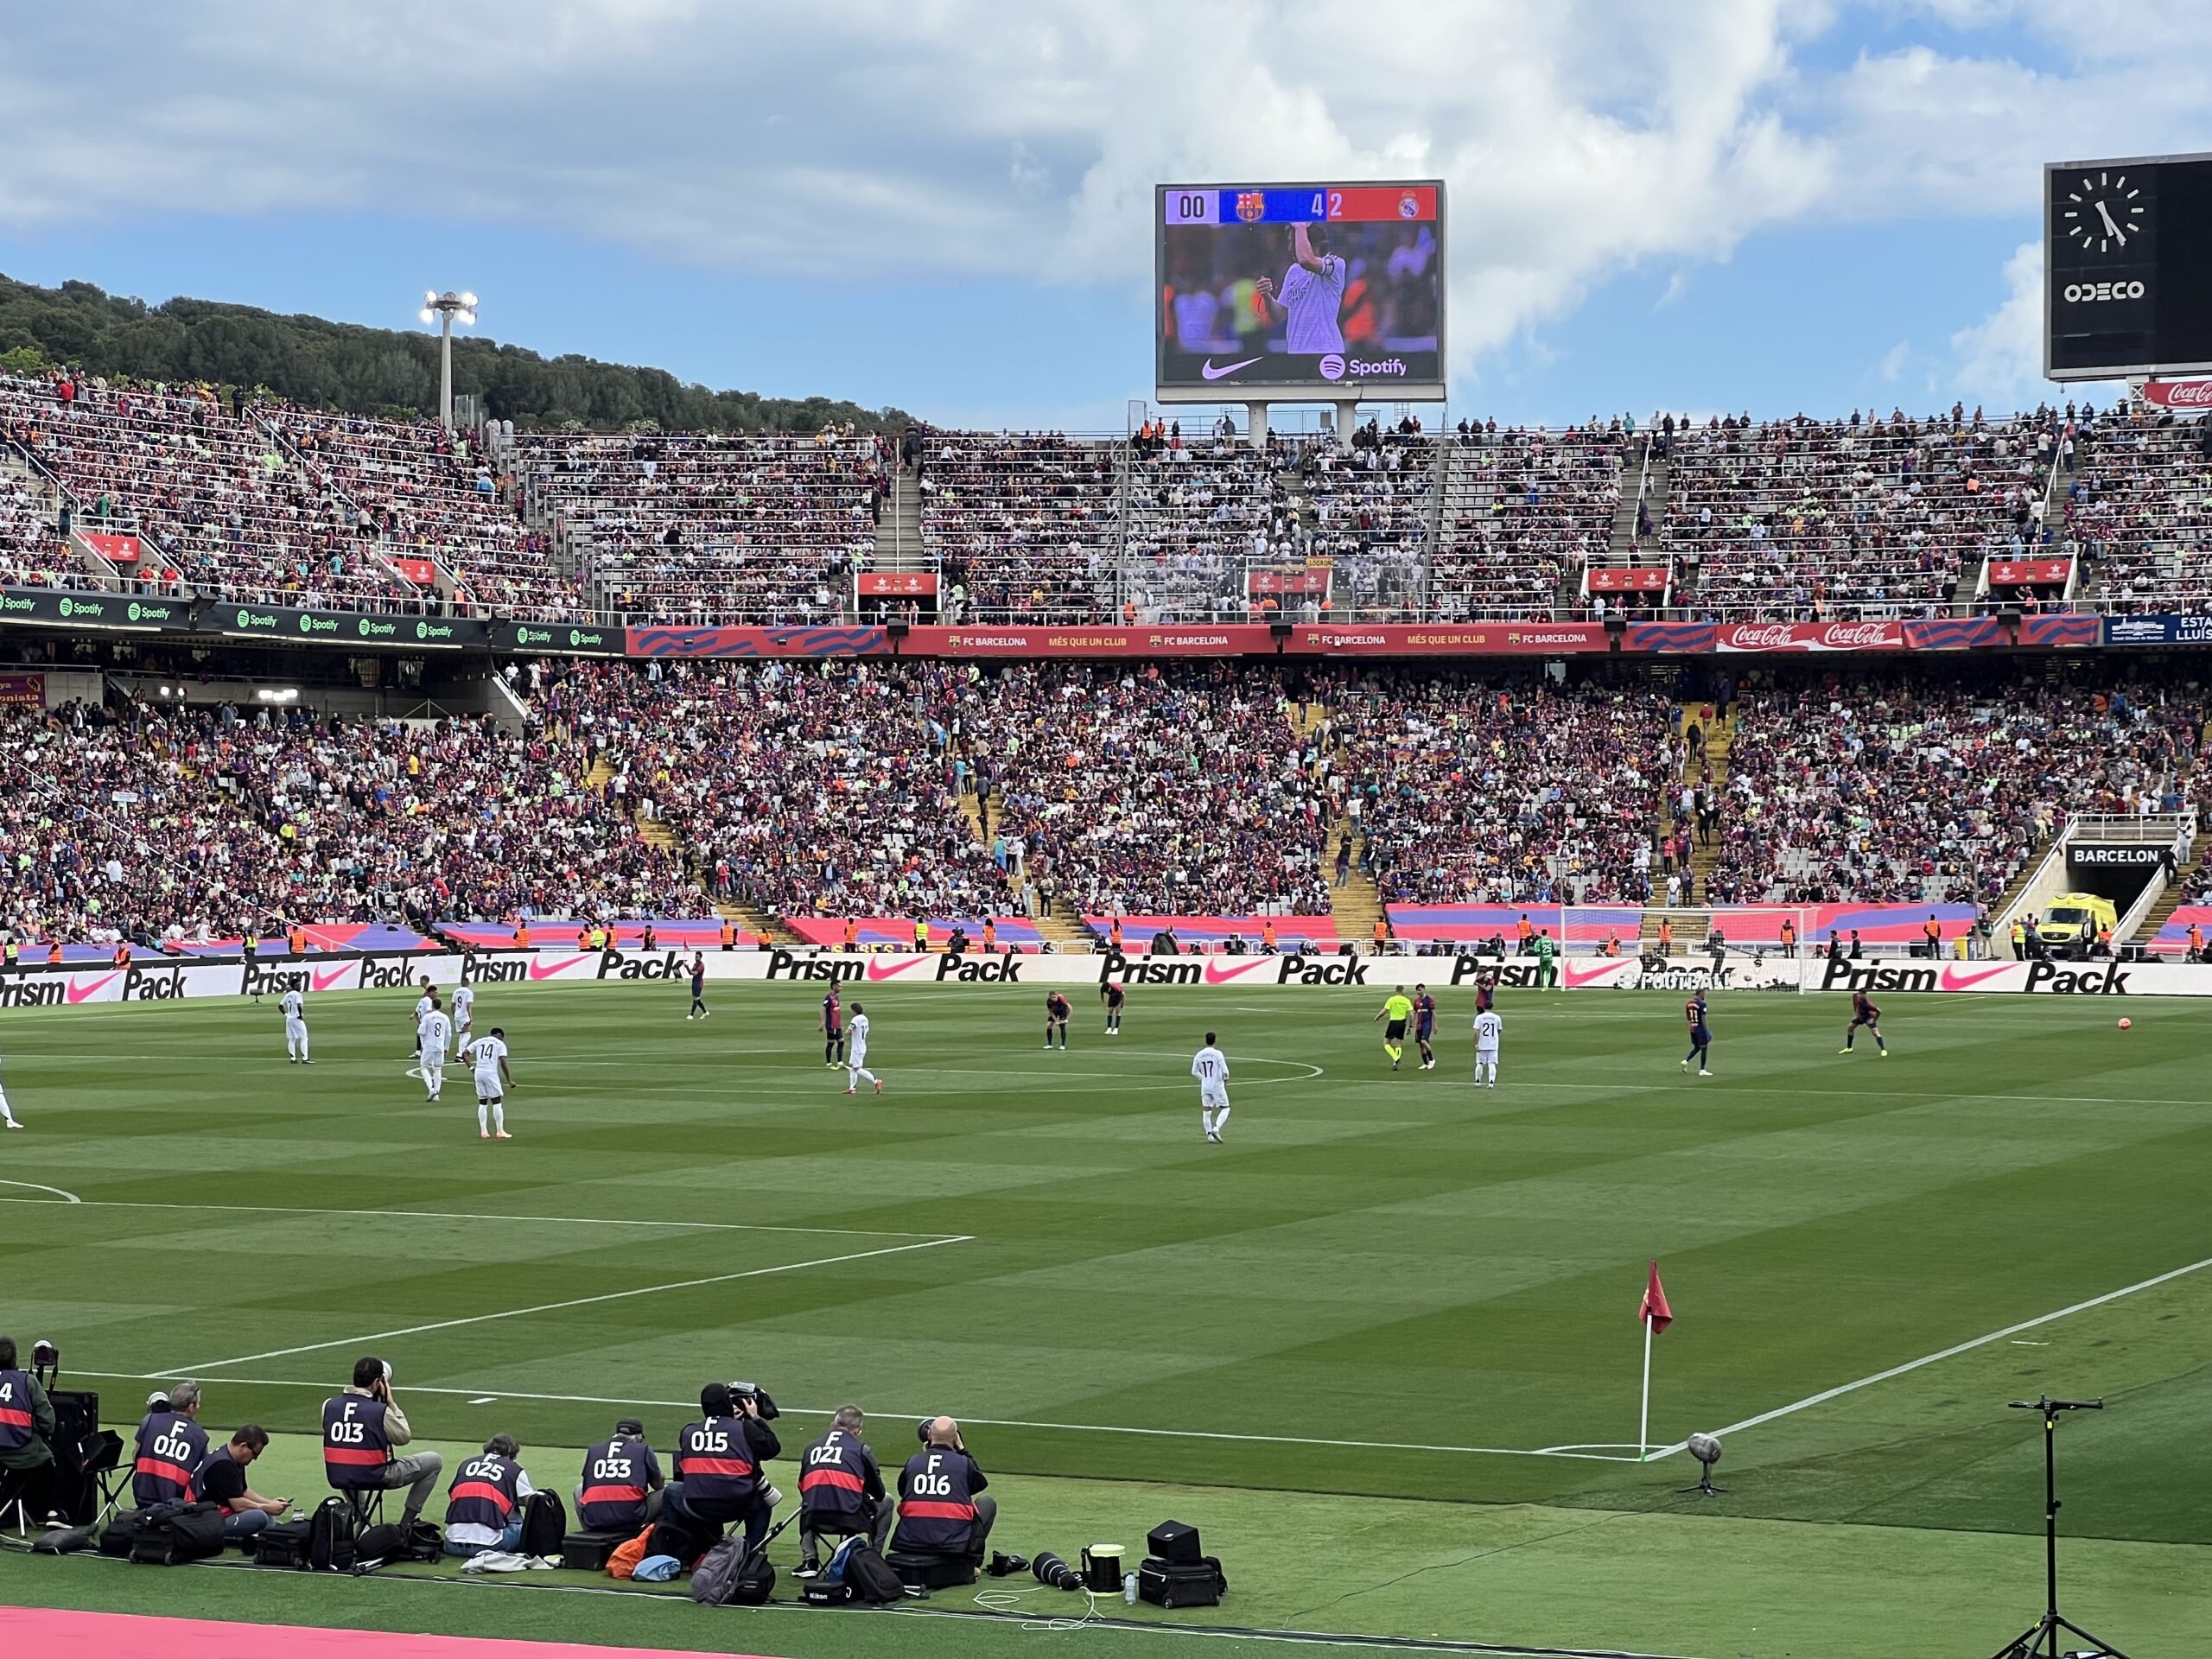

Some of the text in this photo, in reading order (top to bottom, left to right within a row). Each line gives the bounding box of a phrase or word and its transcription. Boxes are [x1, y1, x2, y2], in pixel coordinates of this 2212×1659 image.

[1179, 193, 1342, 219] 00 4 2
[2064, 281, 2145, 302] ODECO
[1349, 359, 1407, 377] Spotify
[5, 598, 35, 612] Spotify
[74, 603, 104, 616] Spotify
[142, 607, 170, 620] Spotify
[250, 614, 277, 627] Spotify
[313, 619, 339, 632] Spotify
[371, 622, 396, 635] Spotify
[428, 625, 453, 638] Spotify
[529, 632, 552, 643] Spotify
[581, 634, 602, 645] Spotify
[1164, 635, 1228, 646] FC BARCELONA
[1322, 635, 1333, 645] FC
[1408, 633, 1484, 645] MÉS QUE UN CLUB
[1522, 633, 1586, 644] FC BARCELONA
[1732, 624, 1798, 646] Coca-Cola
[1825, 623, 1891, 645] Coca-Cola
[963, 636, 1027, 646] FC BARCELONA
[1049, 636, 1127, 647] MÉS QUE UN CLUB
[2075, 849, 2158, 862] BARCELON
[1541, 944, 1552, 954] 25
[359, 956, 415, 988] Pack
[461, 954, 527, 982] Prism
[597, 951, 686, 979] Pack
[766, 951, 865, 980] Prism
[936, 953, 1023, 982] Pack
[1099, 954, 1202, 984] Prism
[1277, 955, 1370, 985] Pack
[1821, 958, 1937, 990] Prism
[122, 964, 187, 1001] Pack
[2024, 962, 2132, 995] Pack
[0, 973, 66, 1007] rism
[457, 995, 463, 1008] 9
[1688, 1009, 1699, 1022] 11
[434, 1022, 442, 1037] 8
[1482, 1022, 1495, 1037] 21
[480, 1044, 494, 1059] 14
[1201, 1060, 1214, 1078] 17
[343, 1402, 358, 1423] F
[170, 1420, 188, 1439] F
[330, 1421, 364, 1444] 013
[703, 1416, 720, 1432] F
[153, 1433, 191, 1462] 010
[690, 1430, 728, 1452] 015
[825, 1431, 842, 1447] F
[607, 1441, 623, 1459] F
[810, 1445, 842, 1465] 021
[465, 1460, 505, 1482] 025
[594, 1458, 632, 1479] 033
[927, 1454, 943, 1474] F
[913, 1473, 951, 1496] 016
